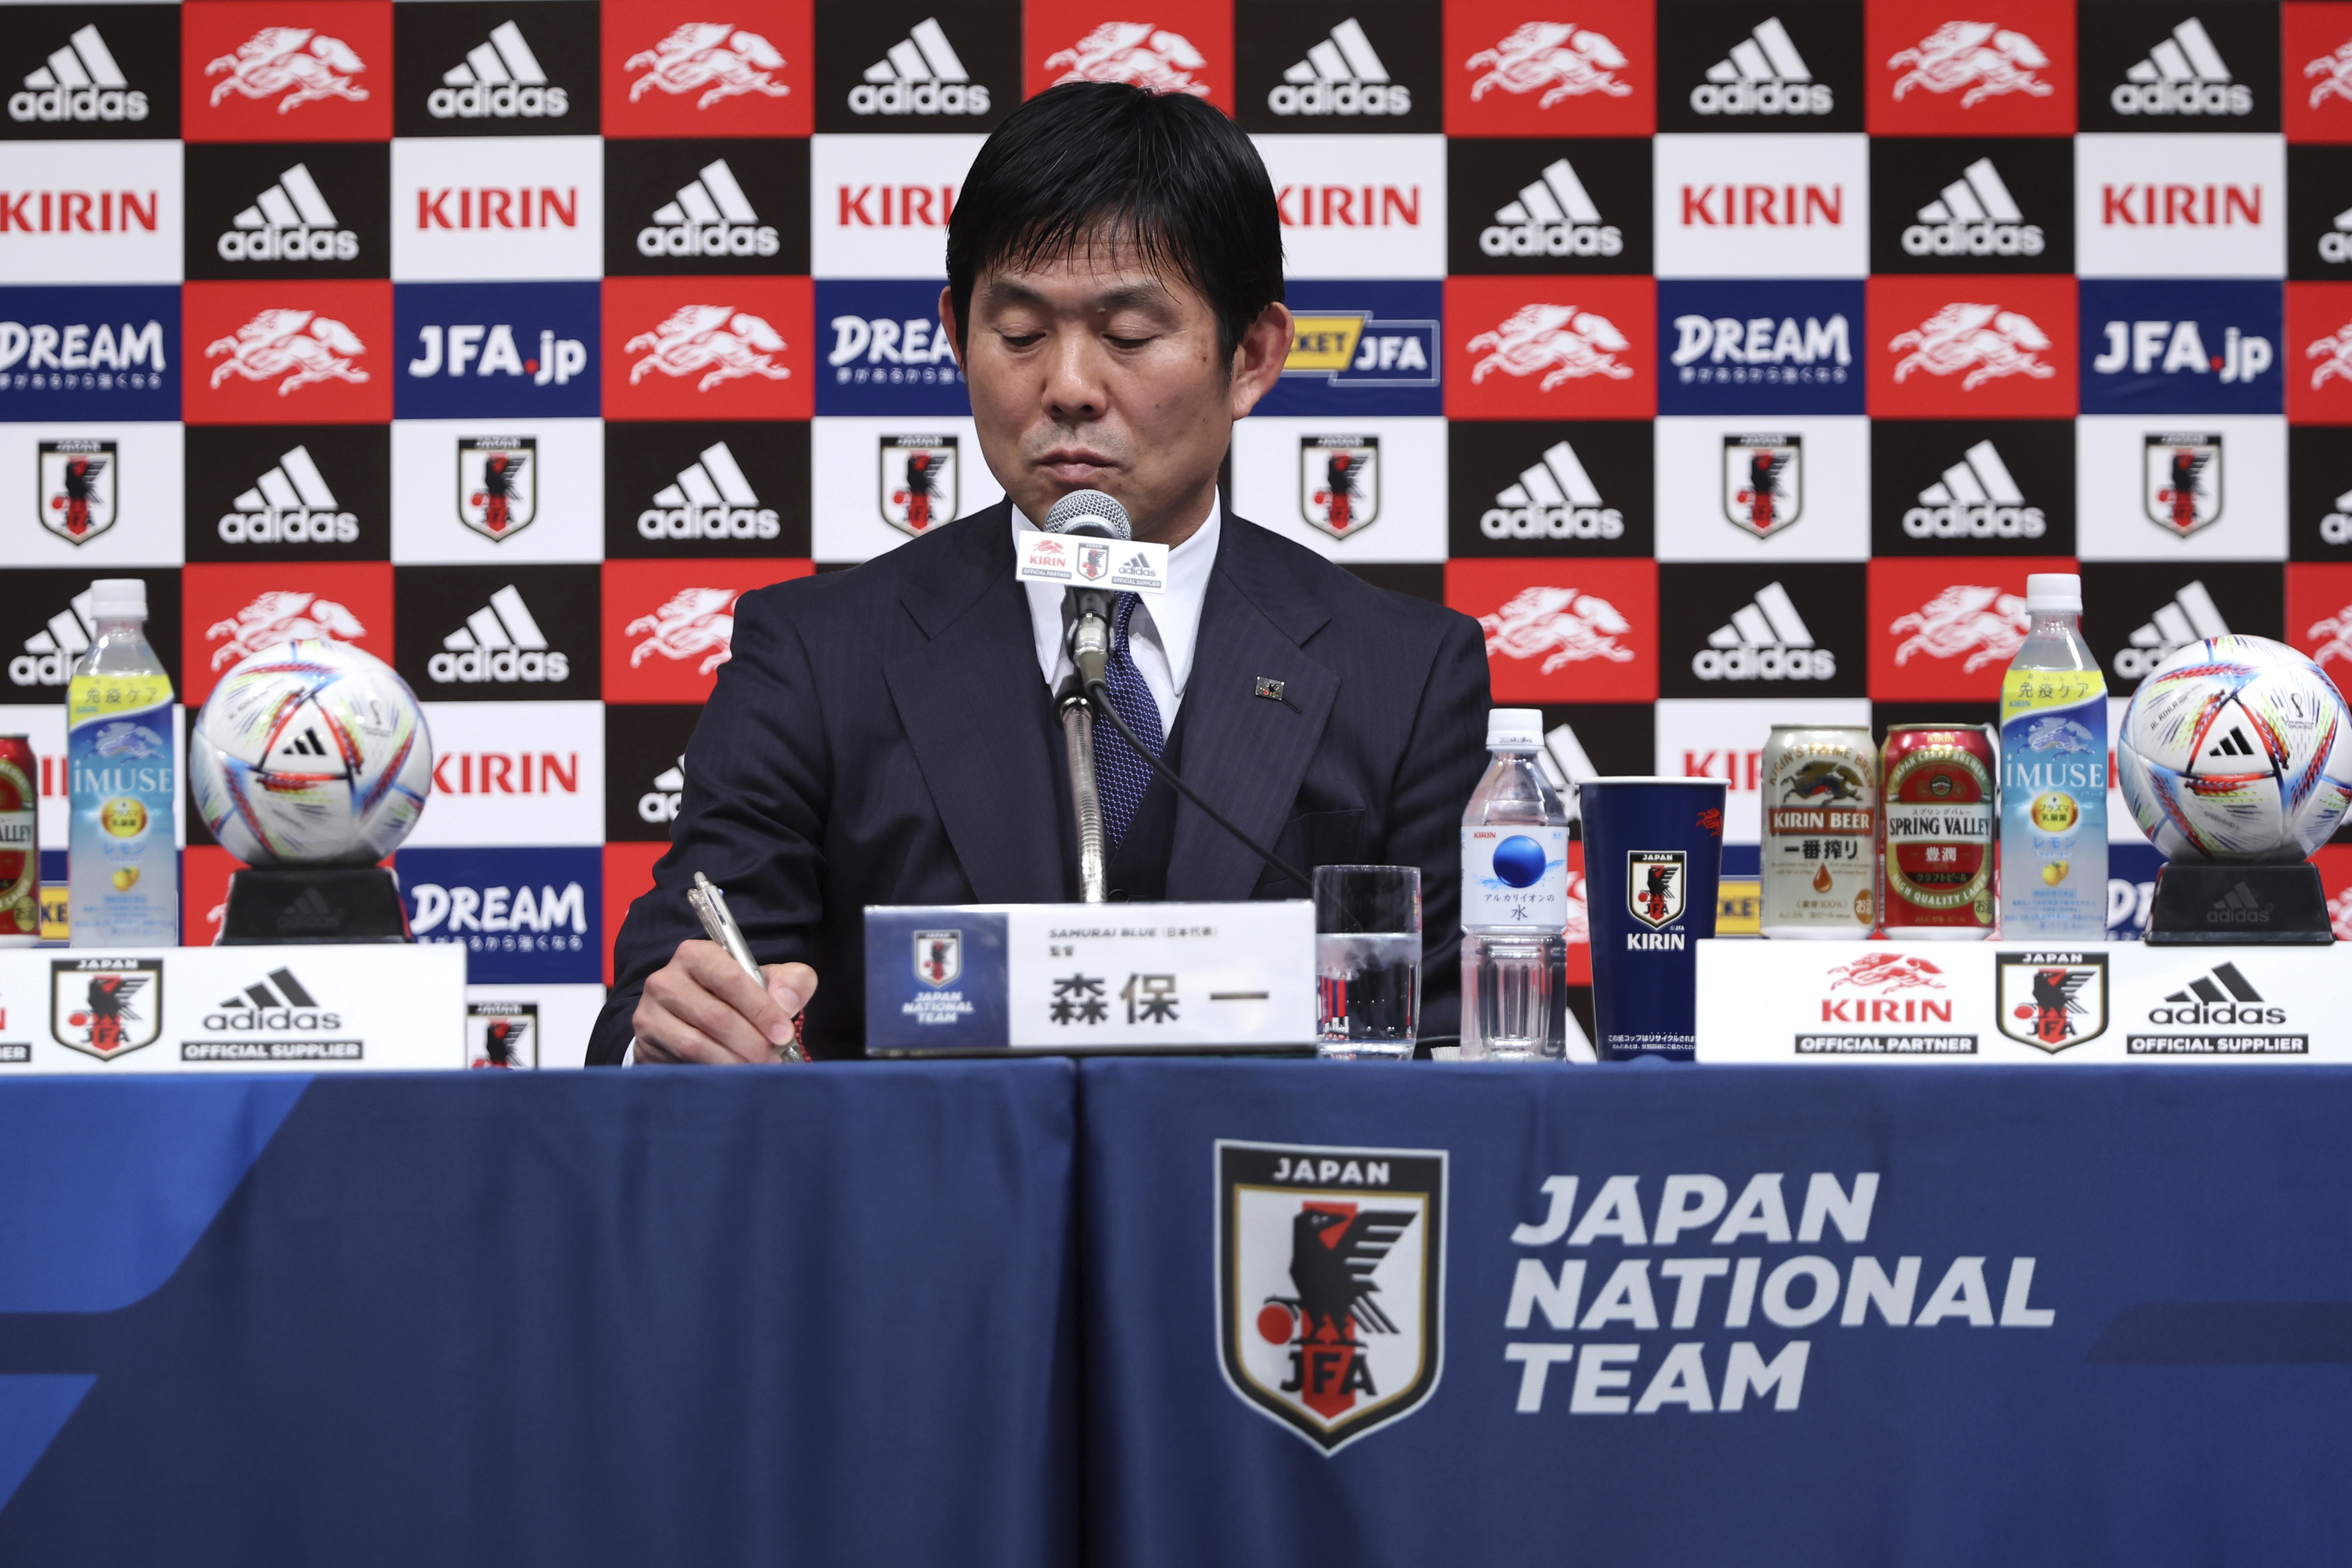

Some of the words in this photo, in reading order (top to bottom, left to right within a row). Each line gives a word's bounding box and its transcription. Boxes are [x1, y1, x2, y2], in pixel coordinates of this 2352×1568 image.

[8, 87, 149, 121] adidas
[427, 82, 569, 118] adidas
[848, 79, 990, 114] adidas
[1268, 79, 1411, 115] adidas
[1690, 79, 1833, 114] adidas
[2111, 79, 2252, 114] adidas
[0, 193, 156, 232] KIRIN
[419, 190, 575, 229] KIRIN
[840, 187, 952, 226] KIRI
[1683, 186, 1840, 225] KIRIN
[2104, 186, 2260, 225] KIRIN
[218, 226, 359, 261] adidas
[637, 222, 780, 256] adidas
[1479, 222, 1623, 256] adidas
[1902, 221, 2044, 255] adidas
[0, 322, 165, 371] DREAM
[409, 325, 586, 385] JFA.jp
[828, 316, 957, 366] DREA
[1290, 331, 1347, 352] KET
[1356, 337, 1427, 369] JFA
[1672, 315, 1850, 368] DREAM
[2095, 321, 2271, 381] JFA.jp
[218, 508, 359, 543] adidas
[637, 505, 780, 539] adidas
[1480, 505, 1624, 539] adidas
[1903, 504, 2045, 537] adidas
[1030, 555, 1066, 567] KIRIN
[1118, 566, 1156, 576] adidas
[9, 652, 75, 685] adi
[428, 649, 569, 683] adidas
[1693, 646, 1836, 680] adidas
[2018, 682, 2088, 698] 免疫ケア
[1927, 734, 1955, 743] KIRIN
[1893, 756, 1916, 781] JAPAN
[2006, 753, 2103, 788] iMUSE
[0, 824, 32, 842] LLEY
[1774, 812, 1824, 828] KIRIN
[1830, 812, 1870, 829] BEER
[1890, 817, 1937, 836] SPRING
[1944, 817, 1991, 836] VALLEY
[1784, 839, 1858, 860] 一番搾り
[1926, 846, 1957, 862] 豊潤
[2034, 837, 2076, 849] レモン
[1892, 873, 1912, 896] HIGH
[1914, 892, 1960, 905] QUALITY
[1962, 873, 1987, 900] LAGER
[1916, 873, 1967, 882] クラフトビール
[410, 883, 587, 934] DREAM
[1484, 894, 1555, 902] アルカリイオンの
[1511, 904, 1528, 921] 水
[1644, 904, 1670, 915] JFA
[2207, 908, 2269, 923] adidas
[1050, 928, 1116, 937] SAMURAI
[1121, 928, 1157, 937] BLUE
[1628, 934, 1684, 950] KIRIN
[77, 958, 138, 971] JAPAN
[2022, 953, 2083, 964] JAPAN
[902, 1001, 974, 1014] NATIONAL
[914, 992, 963, 1002] JAPAN
[1051, 974, 1179, 1025] 森保
[1210, 992, 1269, 1001] 一
[1822, 999, 1952, 1022] KIRIN
[2149, 1002, 2286, 1024] adidas
[203, 1008, 341, 1031] adidas
[917, 1012, 958, 1024] TEAM
[2026, 1021, 2078, 1036] JFA
[80, 1027, 131, 1043] JFA
[185, 1043, 268, 1060] OFFICIAL
[270, 1042, 359, 1059] SUPPLIER
[1801, 1037, 1884, 1052] OFFICIAL
[1887, 1037, 1972, 1052] PARTNER
[2131, 1037, 2215, 1052] OFFICIAL
[2217, 1037, 2304, 1052] SUPPLIER
[1274, 1157, 1390, 1184] JAPAN
[1511, 1172, 1880, 1245] JAPAN
[1505, 1255, 2055, 1329] NATIONAL
[1280, 1351, 1378, 1395] JFA
[1505, 1341, 1810, 1413] TEAM
